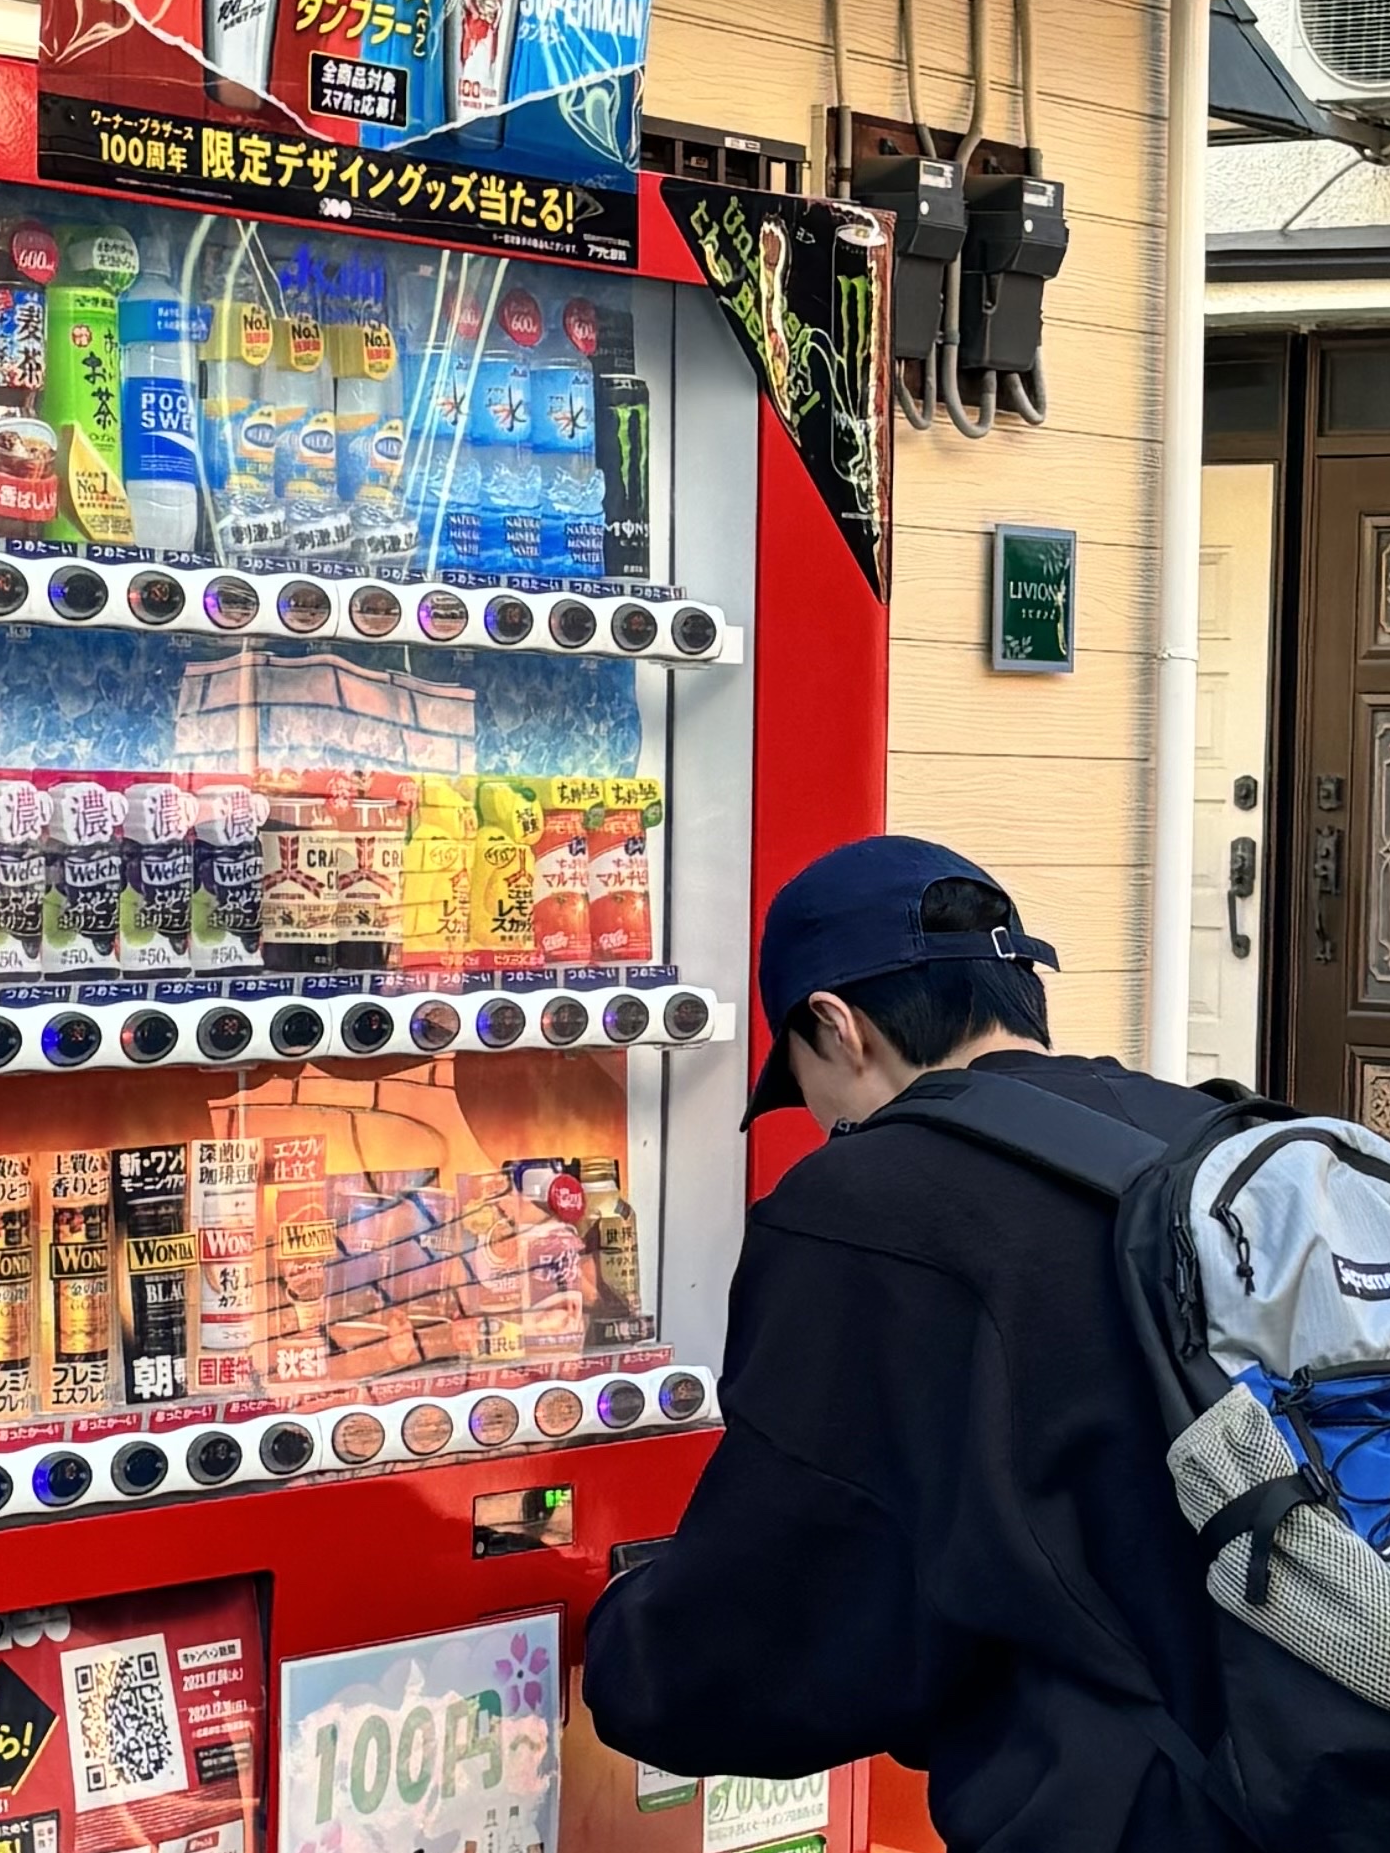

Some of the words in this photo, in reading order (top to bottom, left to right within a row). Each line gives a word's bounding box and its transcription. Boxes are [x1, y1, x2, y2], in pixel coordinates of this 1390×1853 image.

[321, 59, 396, 94] 全商品対象
[91, 109, 195, 141] ワーナー・ブラザース
[99, 132, 189, 174] 100周年
[201, 127, 575, 235] 限定デザイングッズ当たる!
[243, 315, 270, 331] No.1
[291, 322, 320, 340] No.1
[364, 332, 391, 349] No.1
[15, 304, 44, 386] 麦茶
[82, 351, 117, 430] お茶
[0, 484, 57, 511] 香ばしい
[77, 473, 109, 495] No.1
[6, 786, 40, 840] 濃
[75, 788, 111, 840] 濃
[147, 789, 182, 840] 濃
[217, 789, 254, 841] 濃
[130, 1238, 194, 1266] WONDA
